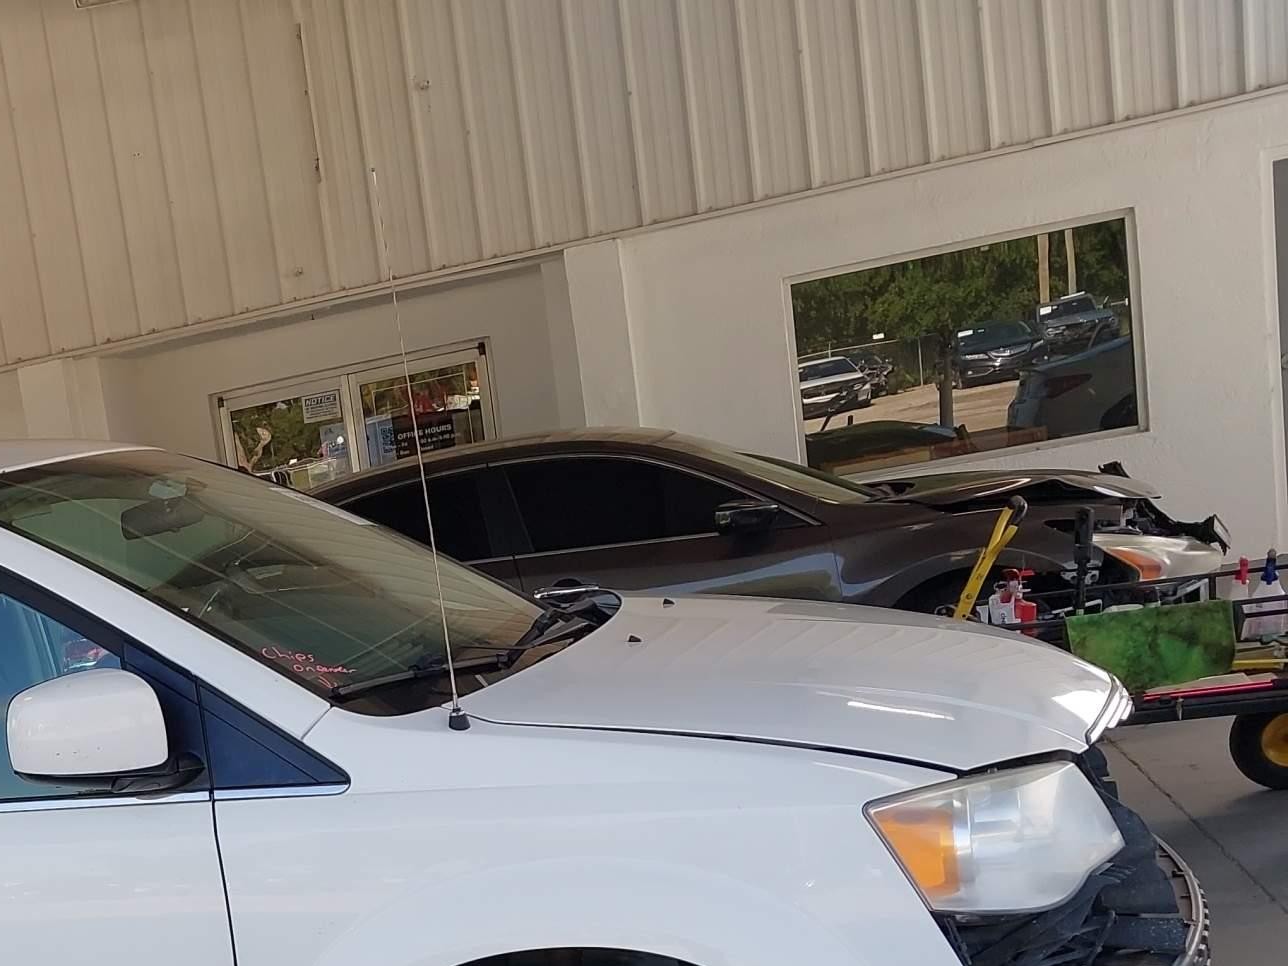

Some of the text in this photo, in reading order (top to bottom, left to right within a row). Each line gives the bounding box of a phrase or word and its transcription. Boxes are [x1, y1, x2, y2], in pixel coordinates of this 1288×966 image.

[305, 394, 336, 407] NOTICE
[425, 423, 452, 435] HOURS
[262, 646, 314, 662] Chips
